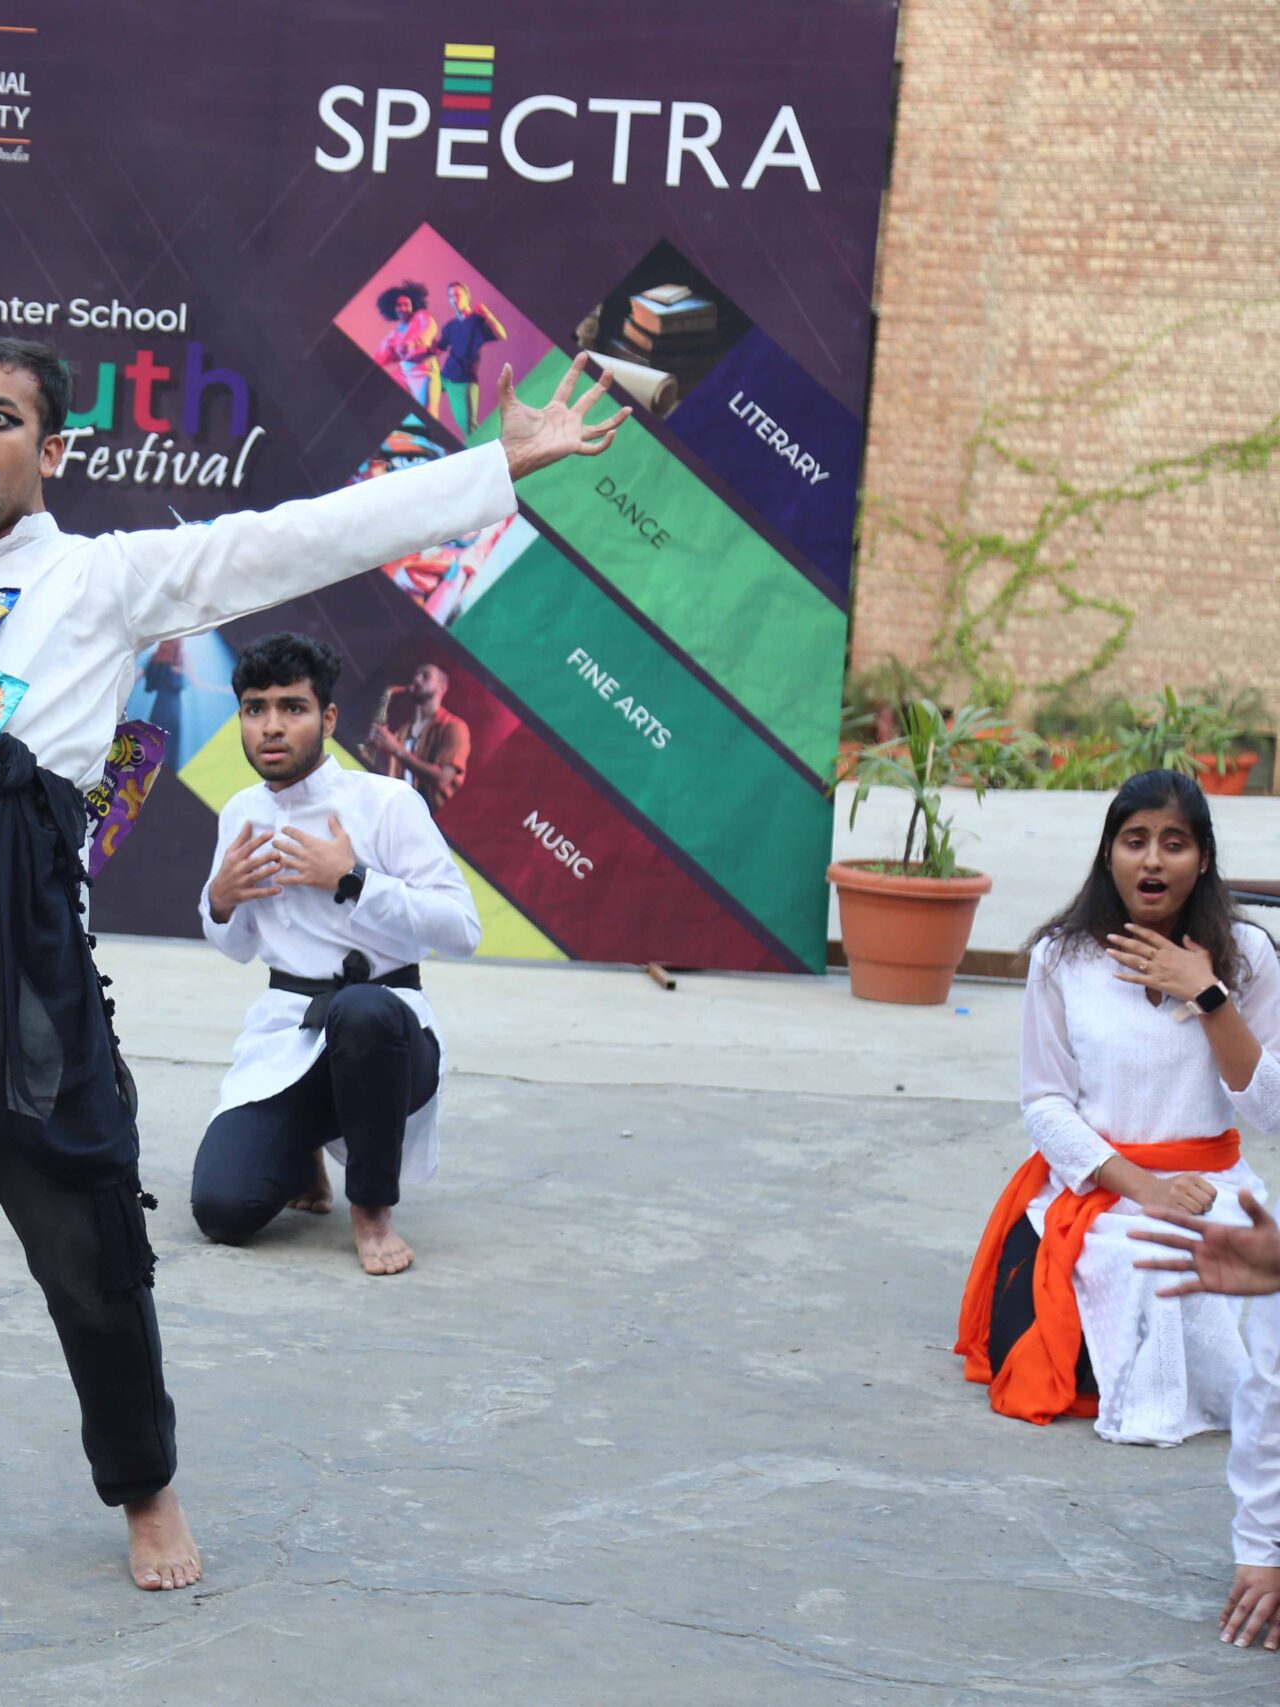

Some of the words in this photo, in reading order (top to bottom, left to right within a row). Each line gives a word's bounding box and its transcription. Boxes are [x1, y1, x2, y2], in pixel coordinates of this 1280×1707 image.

[315, 84, 822, 192] SPECTRA
[68, 298, 187, 332] School
[54, 425, 266, 488] Festival
[728, 391, 830, 486] LITERARY
[593, 476, 671, 551] DANCE
[566, 647, 618, 702] FINE
[613, 697, 673, 750] ARTS
[522, 811, 594, 880] MUSIC
